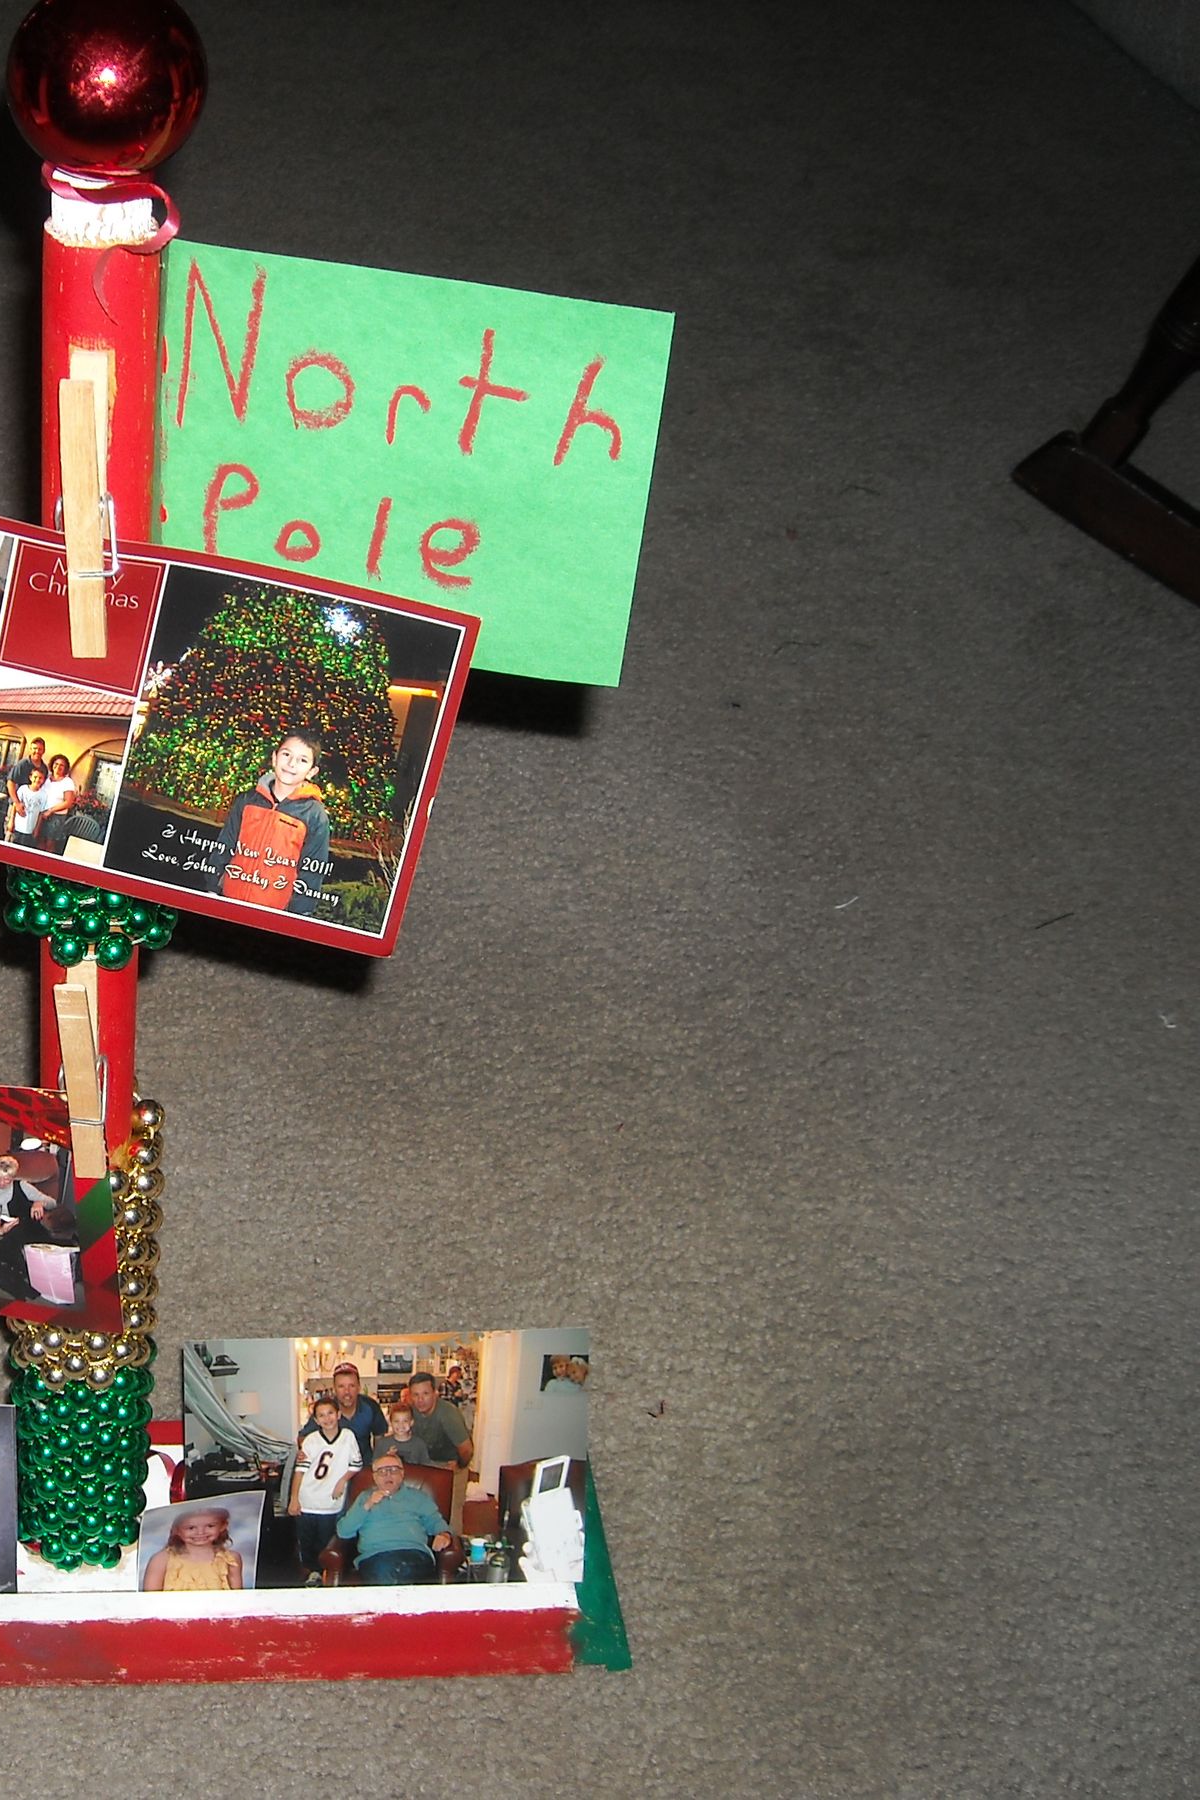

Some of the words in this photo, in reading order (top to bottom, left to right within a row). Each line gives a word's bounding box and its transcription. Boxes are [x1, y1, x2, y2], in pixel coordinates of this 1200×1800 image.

[175, 257, 623, 467] North
[203, 462, 481, 590] Pole
[29, 572, 139, 609] Chras
[161, 823, 177, 838] &
[180, 829, 225, 854] Happy
[230, 840, 259, 856] New
[263, 847, 297, 867] Year
[301, 857, 334, 876] 2011!
[225, 864, 269, 889] Becky
[273, 875, 288, 889] &
[292, 879, 340, 907] Danny
[314, 1450, 334, 1480] 6
